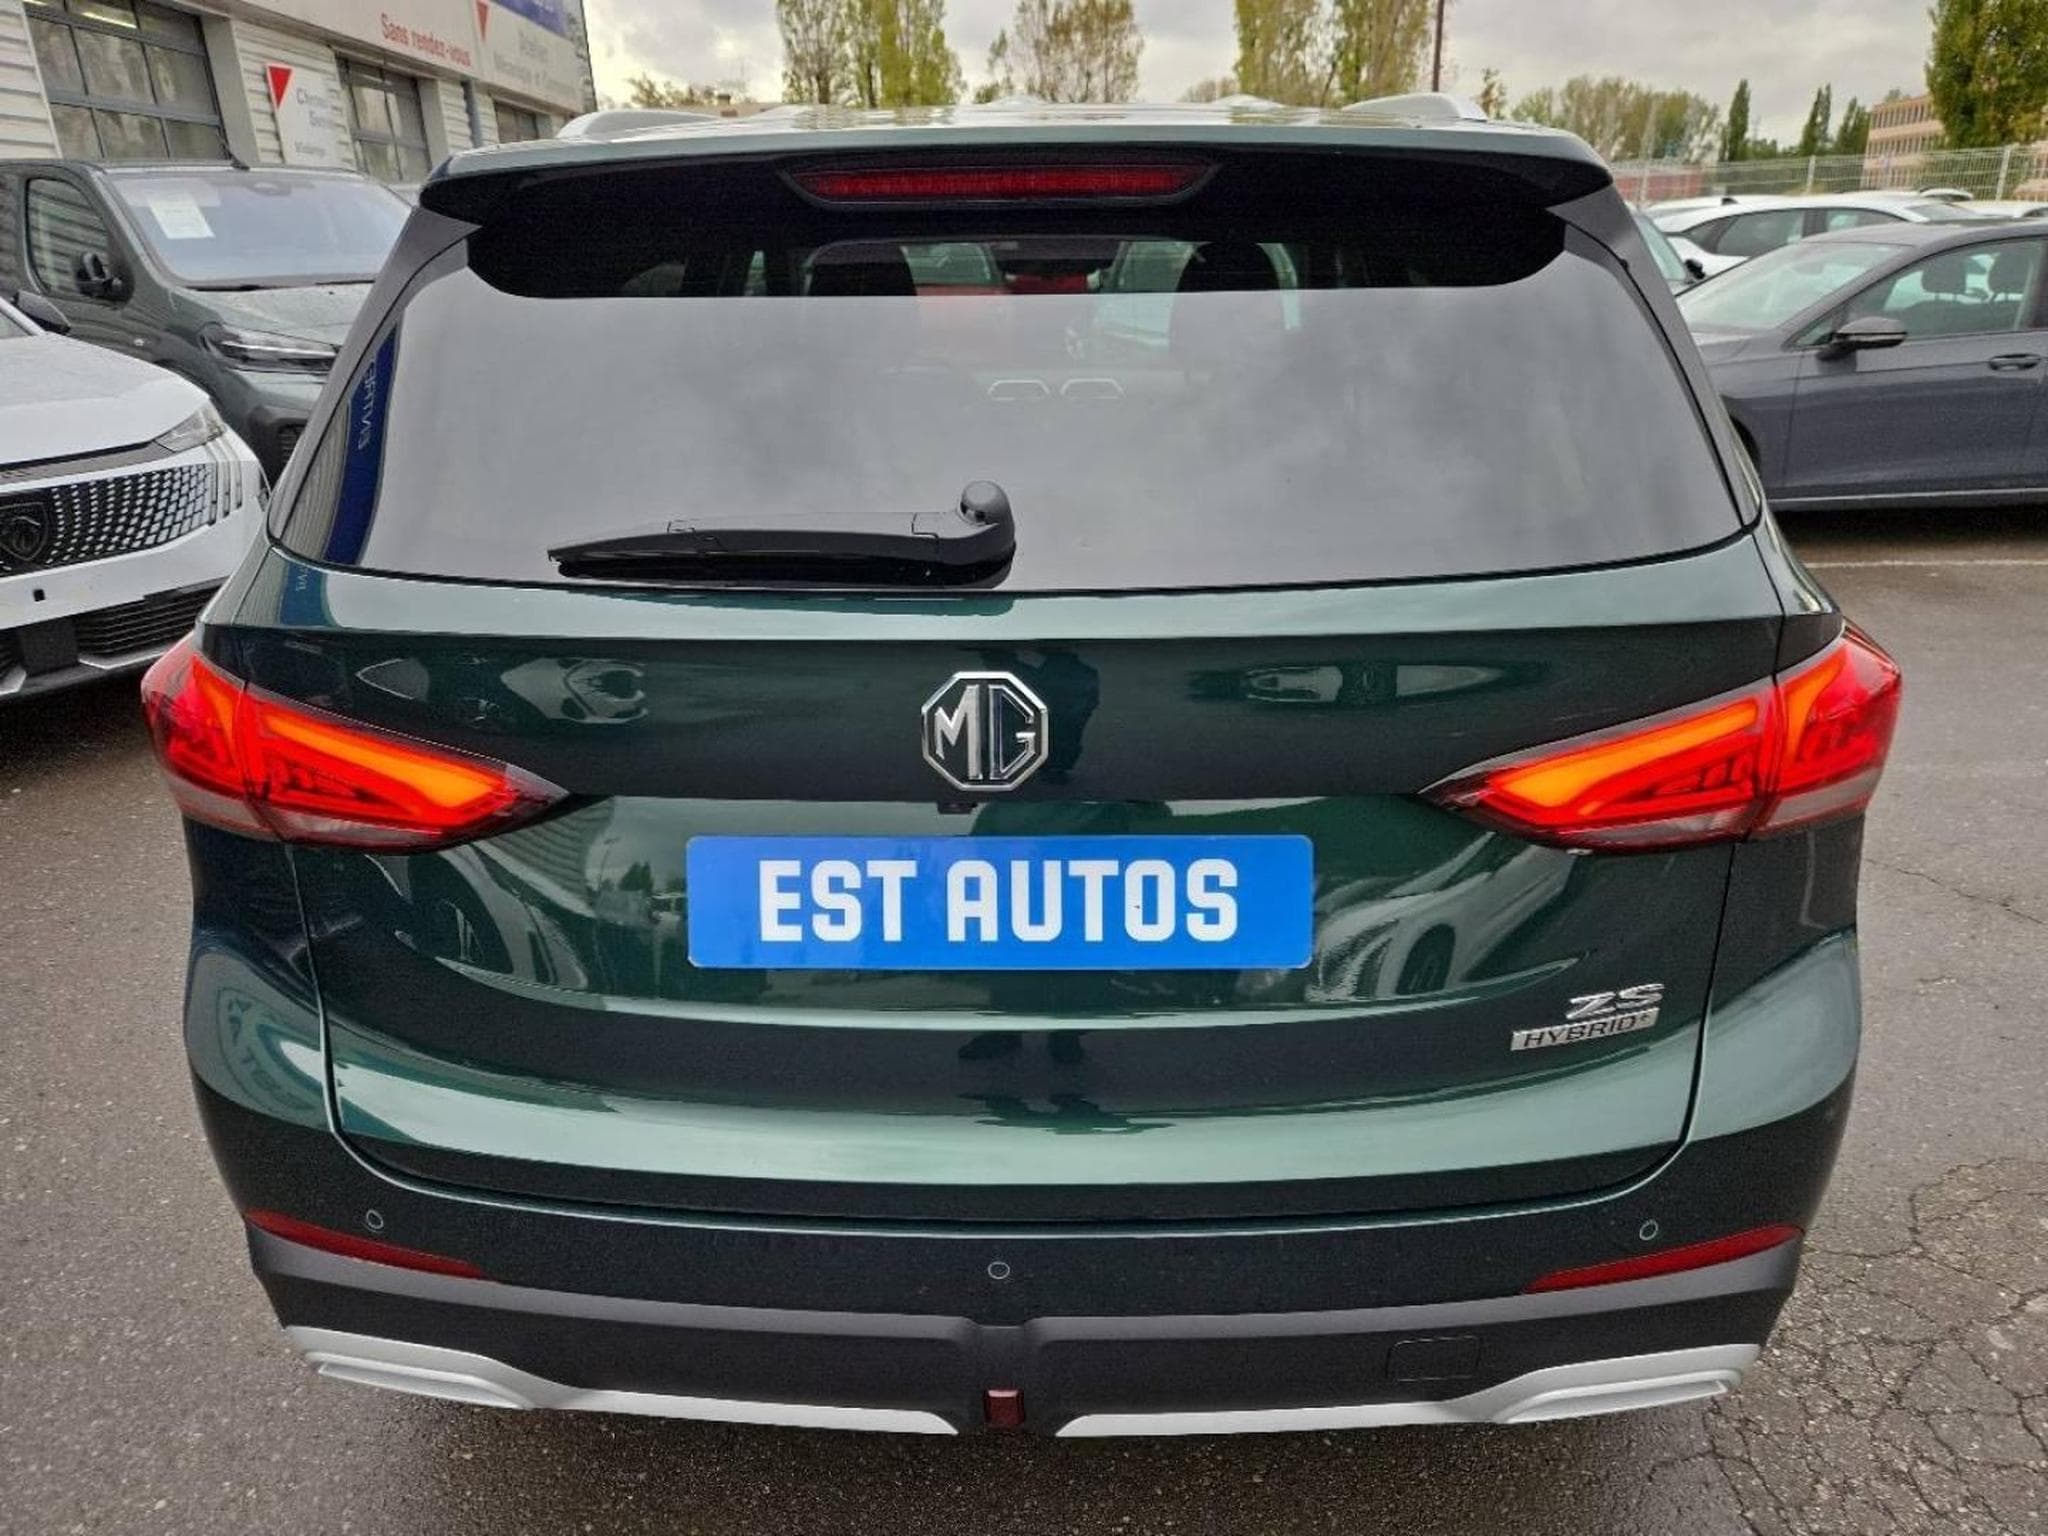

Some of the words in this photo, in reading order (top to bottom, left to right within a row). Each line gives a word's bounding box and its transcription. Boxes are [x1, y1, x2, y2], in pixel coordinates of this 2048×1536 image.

[381, 13, 409, 45] Sans
[934, 684, 1036, 781] MG
[758, 859, 917, 943] EST
[946, 858, 1239, 943] AUTOS
[1565, 983, 1666, 1020] ZS
